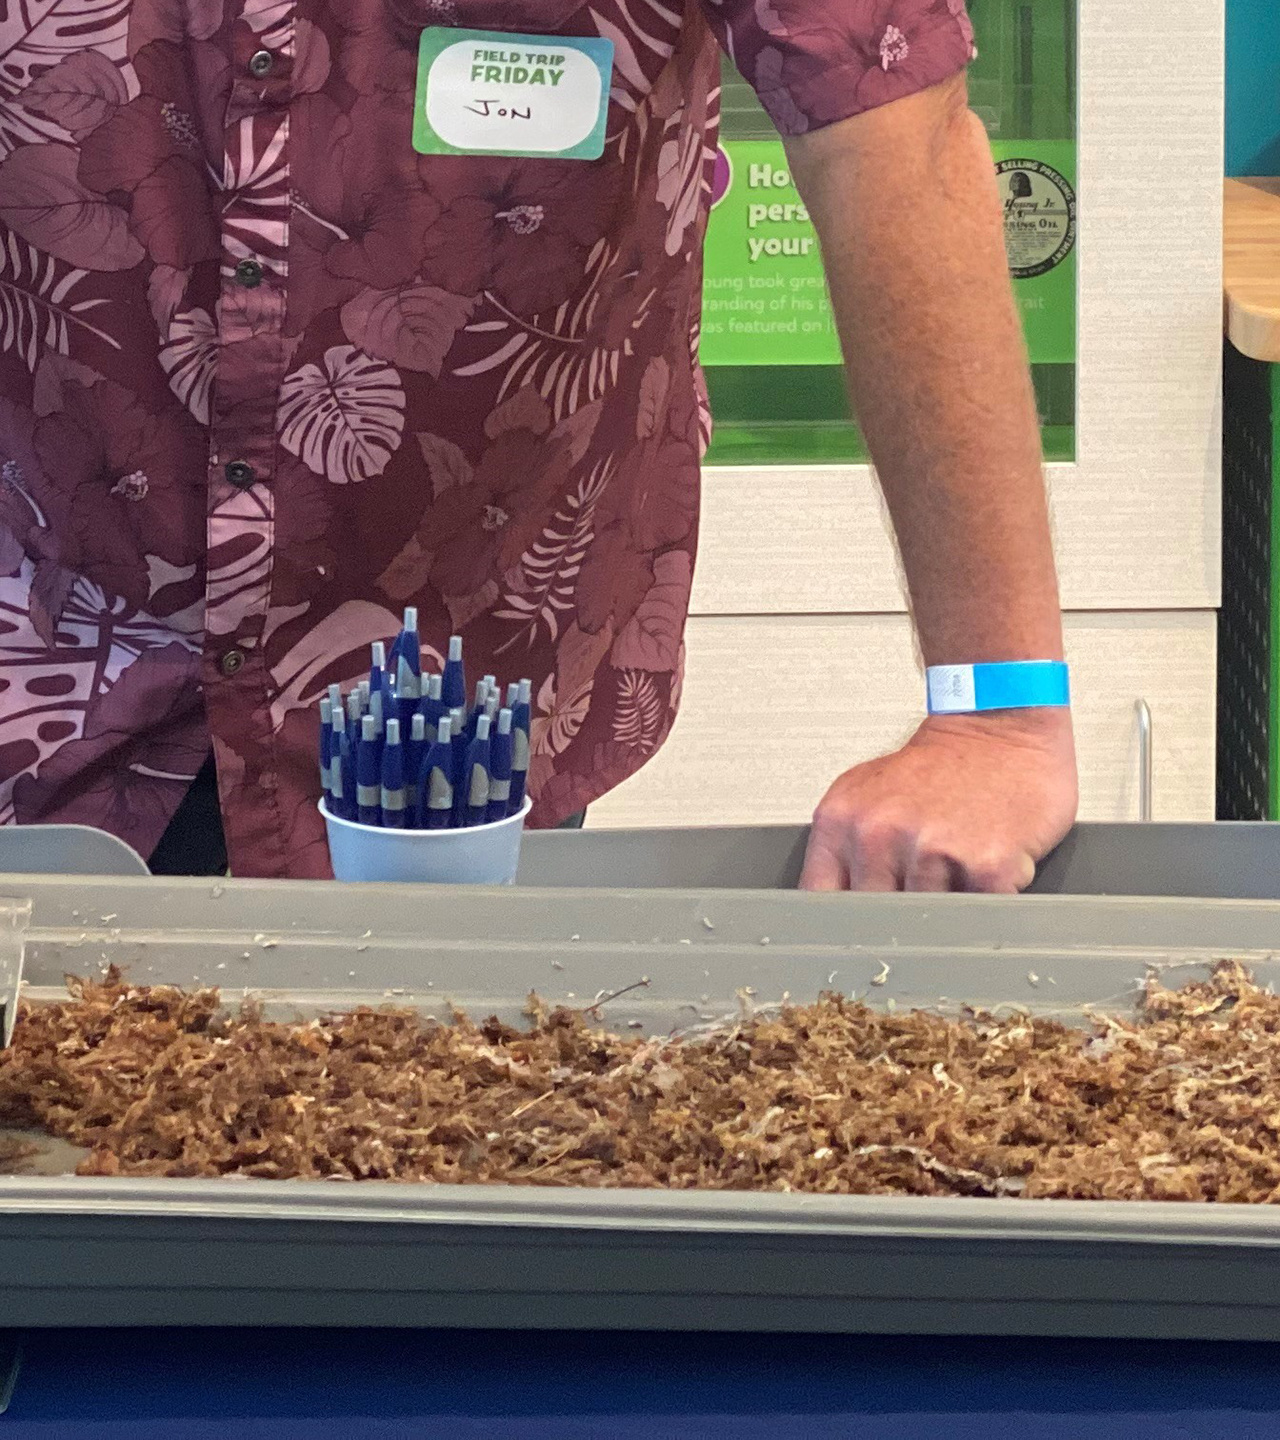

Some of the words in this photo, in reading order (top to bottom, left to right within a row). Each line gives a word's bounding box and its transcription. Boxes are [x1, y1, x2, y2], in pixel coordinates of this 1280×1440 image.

[472, 49, 522, 63] FIELD
[524, 52, 566, 67] TRIP
[470, 65, 565, 87] FRIDAY
[748, 237, 815, 262] your
[749, 272, 785, 288] took
[769, 295, 787, 310] of
[791, 296, 814, 310] his
[728, 317, 797, 333] featured
[801, 321, 822, 332] on
